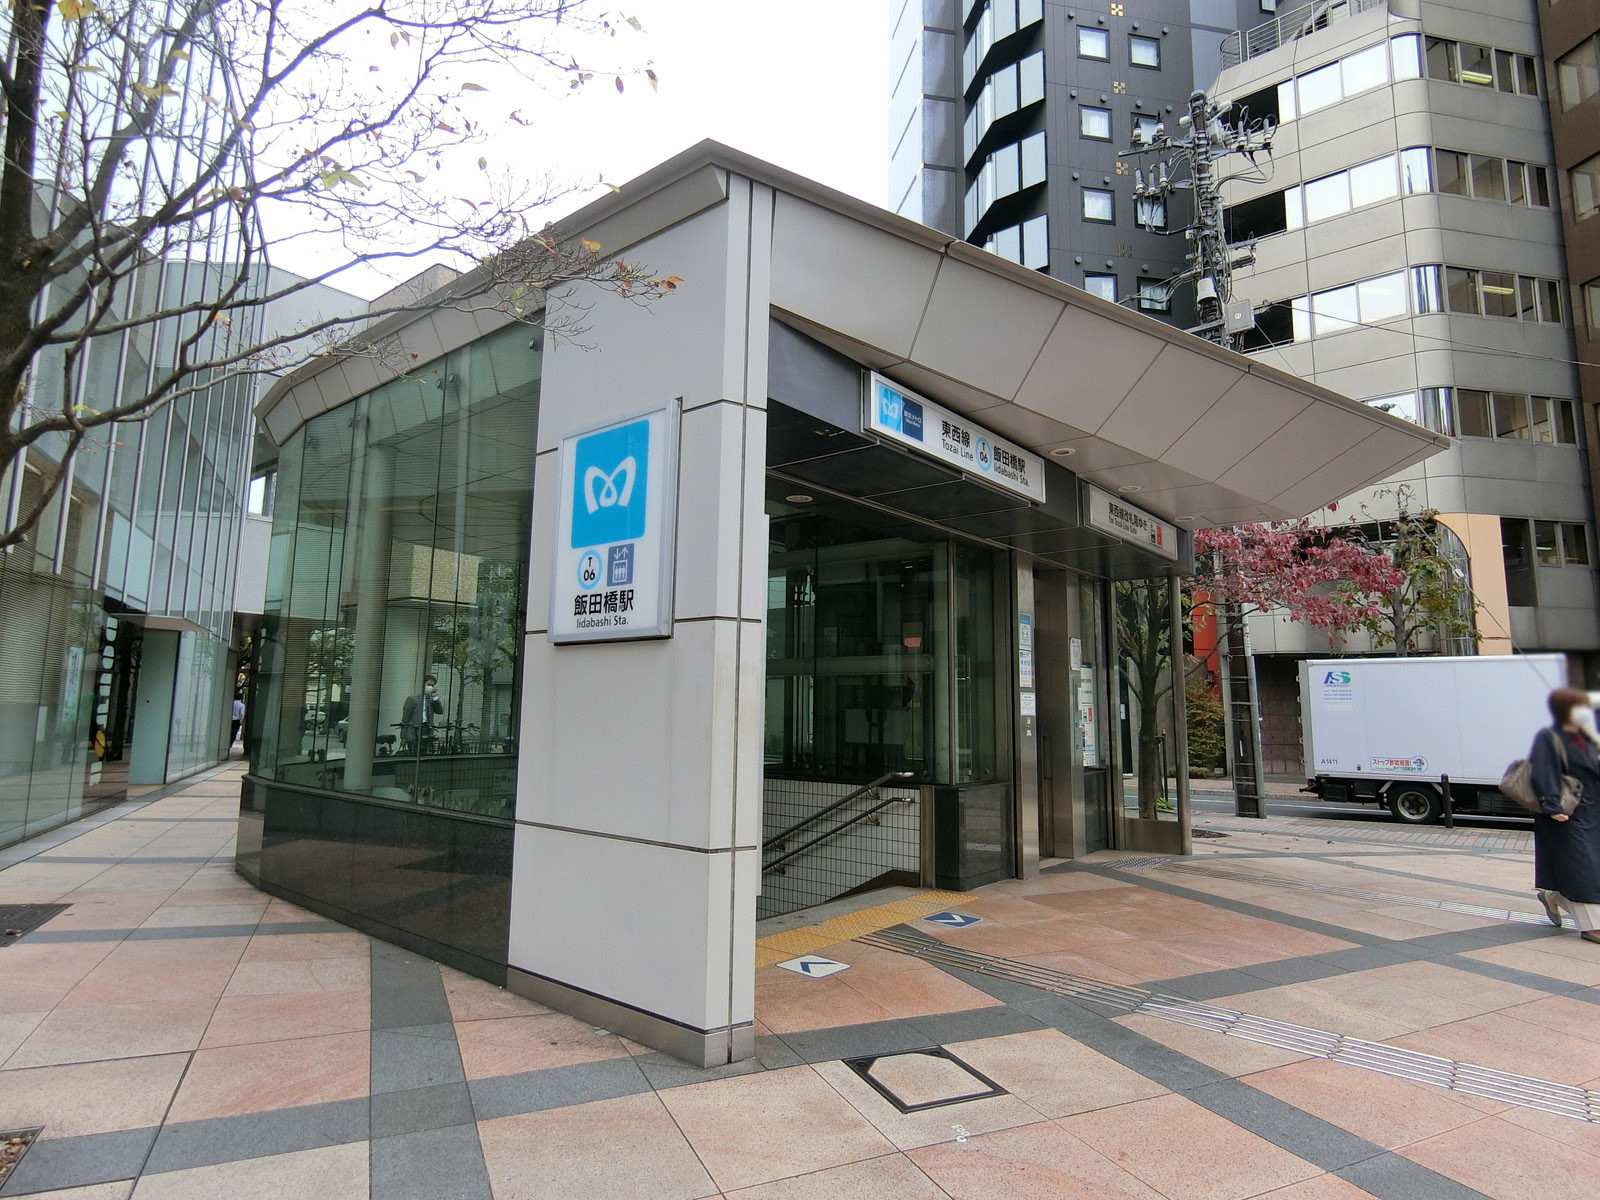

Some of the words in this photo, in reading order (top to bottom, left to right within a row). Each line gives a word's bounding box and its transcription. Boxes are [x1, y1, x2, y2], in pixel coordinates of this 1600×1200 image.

[941, 420, 971, 448] 東西線
[941, 437, 959, 455] Tozai
[960, 447, 974, 462] Line
[982, 441, 986, 451] T
[979, 451, 989, 463] 06
[993, 445, 1026, 474] 飯田橋駅
[993, 462, 1019, 482] Iidabashi
[1019, 474, 1030, 487] Sta.
[587, 556, 593, 567] T
[583, 569, 596, 581] 06
[573, 589, 634, 616] 飯田橋駅
[576, 615, 612, 629] Iidabashi
[613, 615, 629, 626] Sta.
